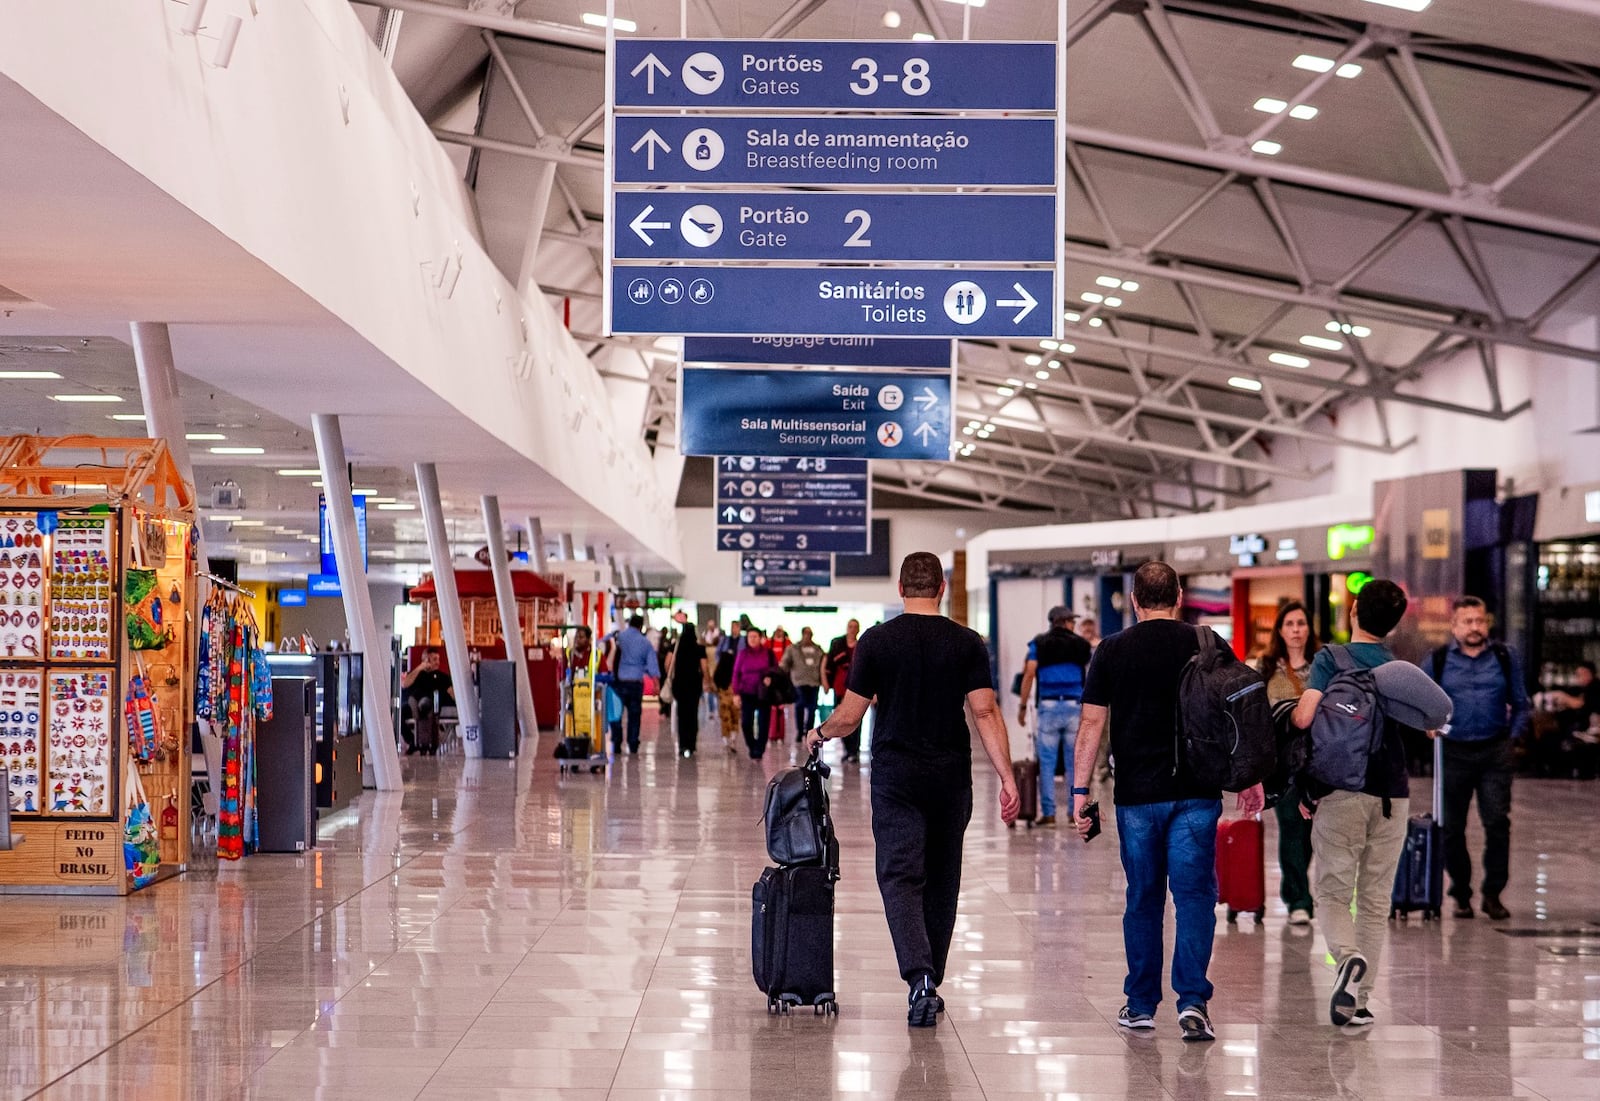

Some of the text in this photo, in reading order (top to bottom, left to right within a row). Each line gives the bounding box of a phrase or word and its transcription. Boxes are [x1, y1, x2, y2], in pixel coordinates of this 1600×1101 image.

[742, 54, 823, 73] Portões
[849, 57, 931, 96] 3-8
[742, 77, 800, 95] Gates
[746, 129, 969, 152] Sala de amamentação
[747, 151, 938, 172] Breastfeeding room
[740, 206, 809, 224] Portão
[843, 209, 872, 247] 2
[739, 230, 787, 247] Gate
[818, 280, 925, 300] Sanitários
[861, 304, 927, 323] Toilets
[832, 384, 869, 397] Saída
[842, 398, 866, 411] Exit
[741, 418, 866, 432] Sala Multissensorial
[779, 432, 866, 446] Sensory Room
[796, 457, 826, 472] 4-8
[796, 534, 808, 549] 3
[65, 829, 105, 841] FEITO
[75, 846, 94, 858] NO
[59, 863, 109, 875] BRASIL
